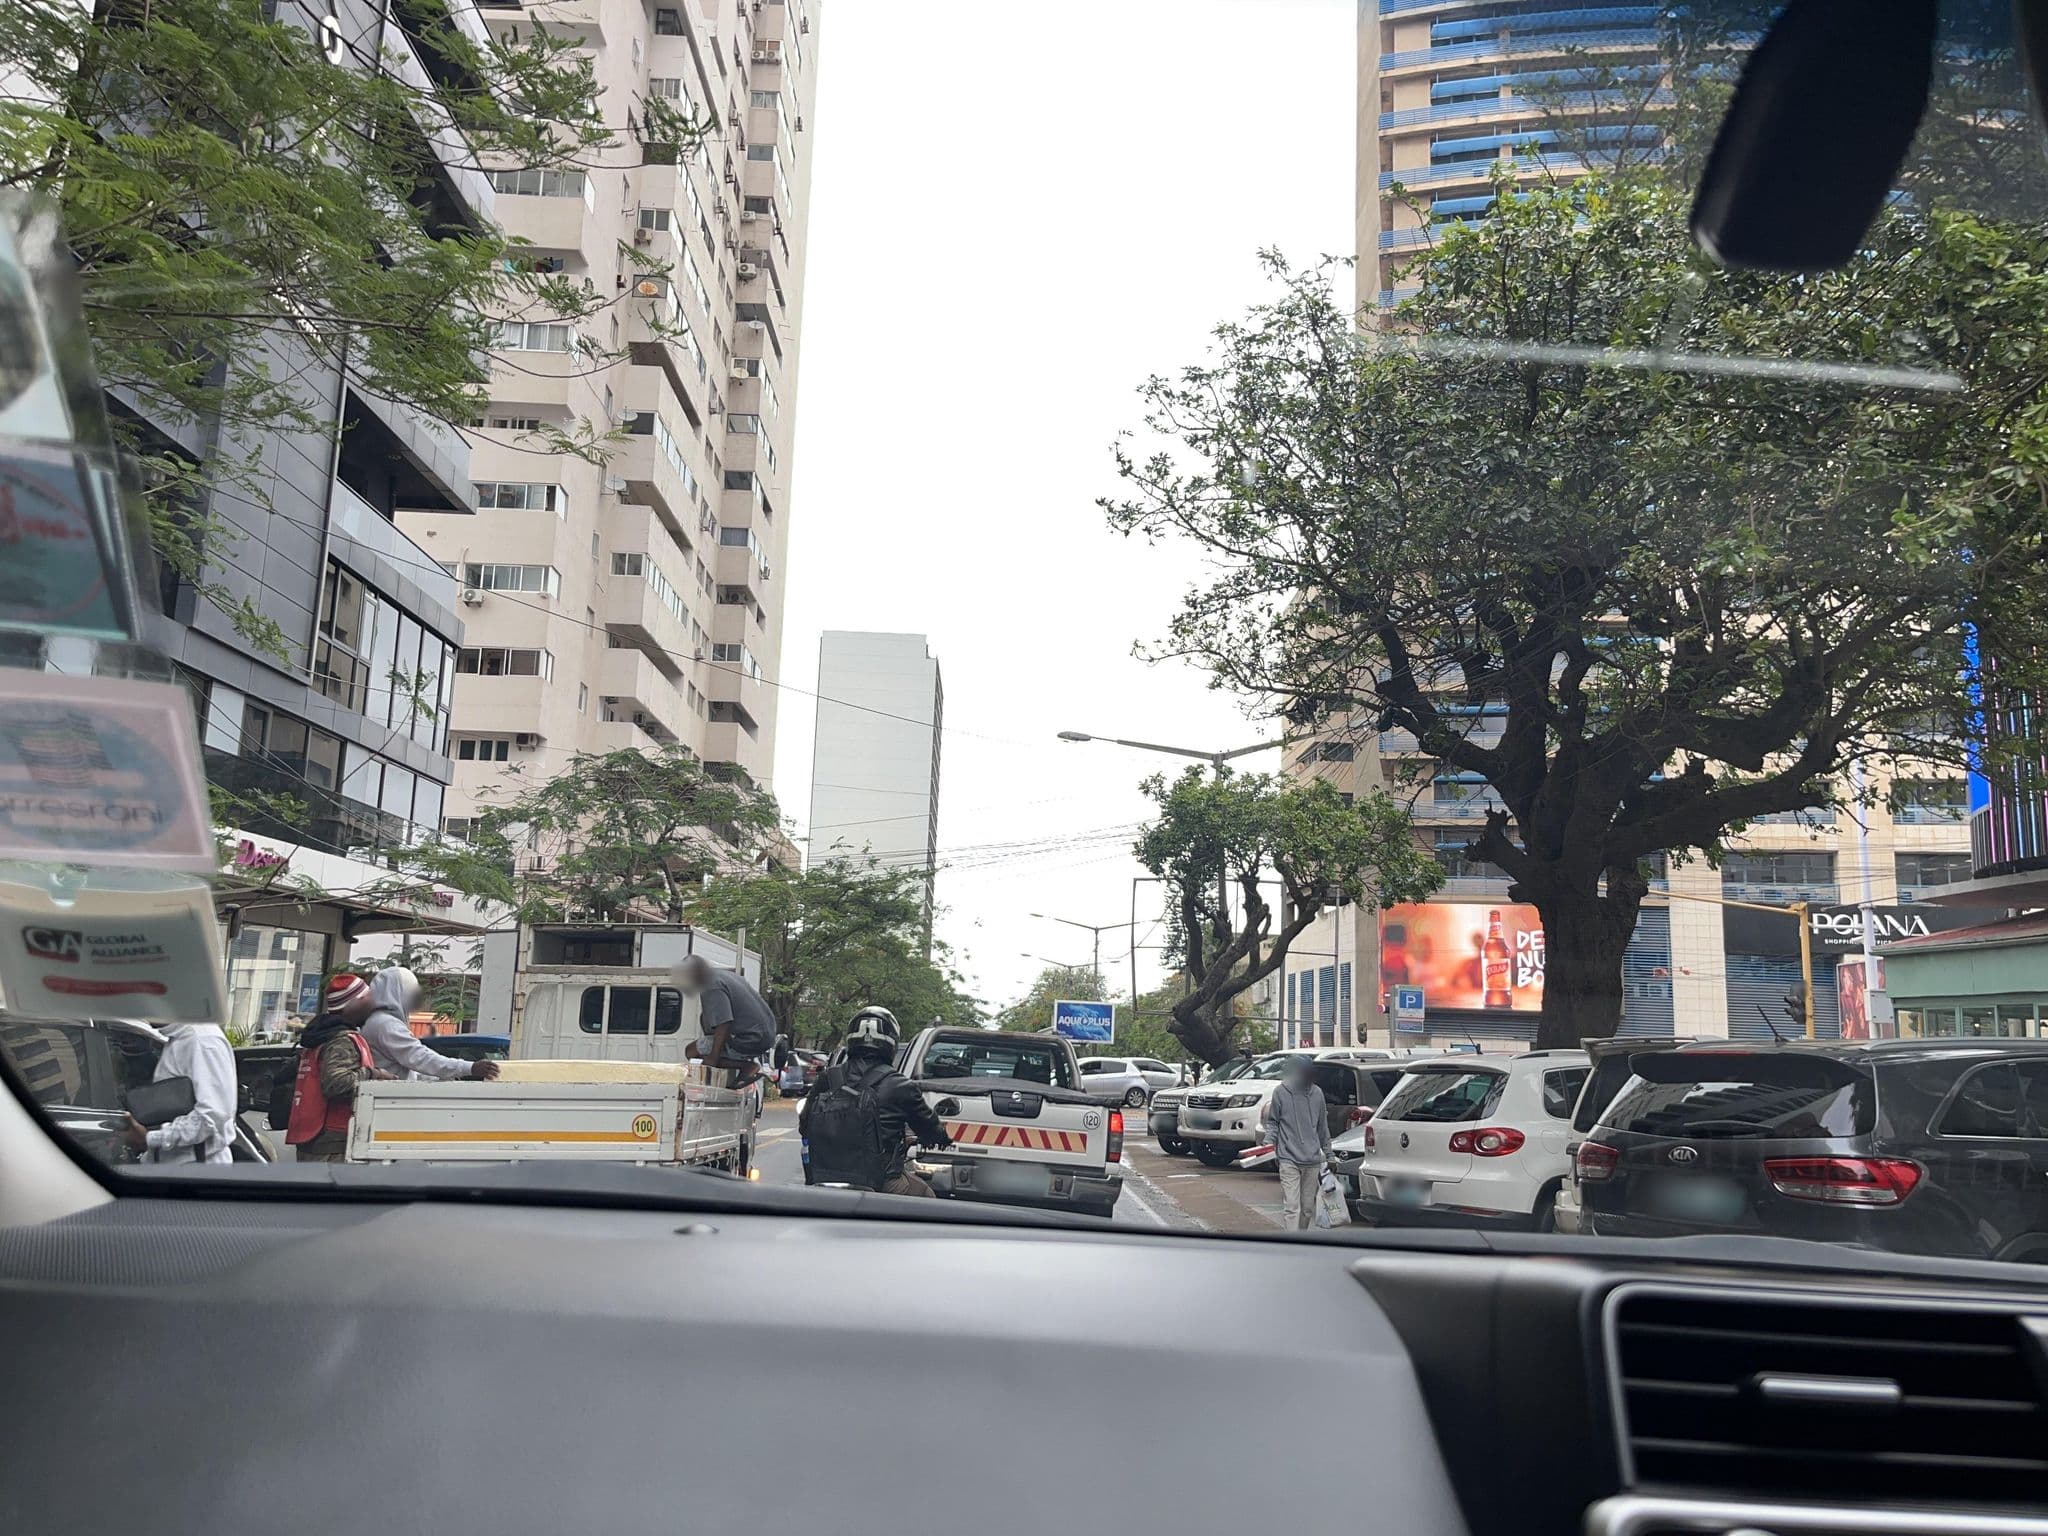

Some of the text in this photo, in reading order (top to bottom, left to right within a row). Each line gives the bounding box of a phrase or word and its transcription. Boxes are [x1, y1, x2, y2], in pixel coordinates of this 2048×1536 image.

[1812, 913, 1931, 936] POLANA
[86, 934, 147, 945] GLOBAL
[91, 943, 170, 957] ALLIANCE
[1406, 995, 1416, 1009] P
[635, 1120, 652, 1133] 100
[1086, 1115, 1099, 1127] 120
[1673, 1149, 1692, 1161] KIA
